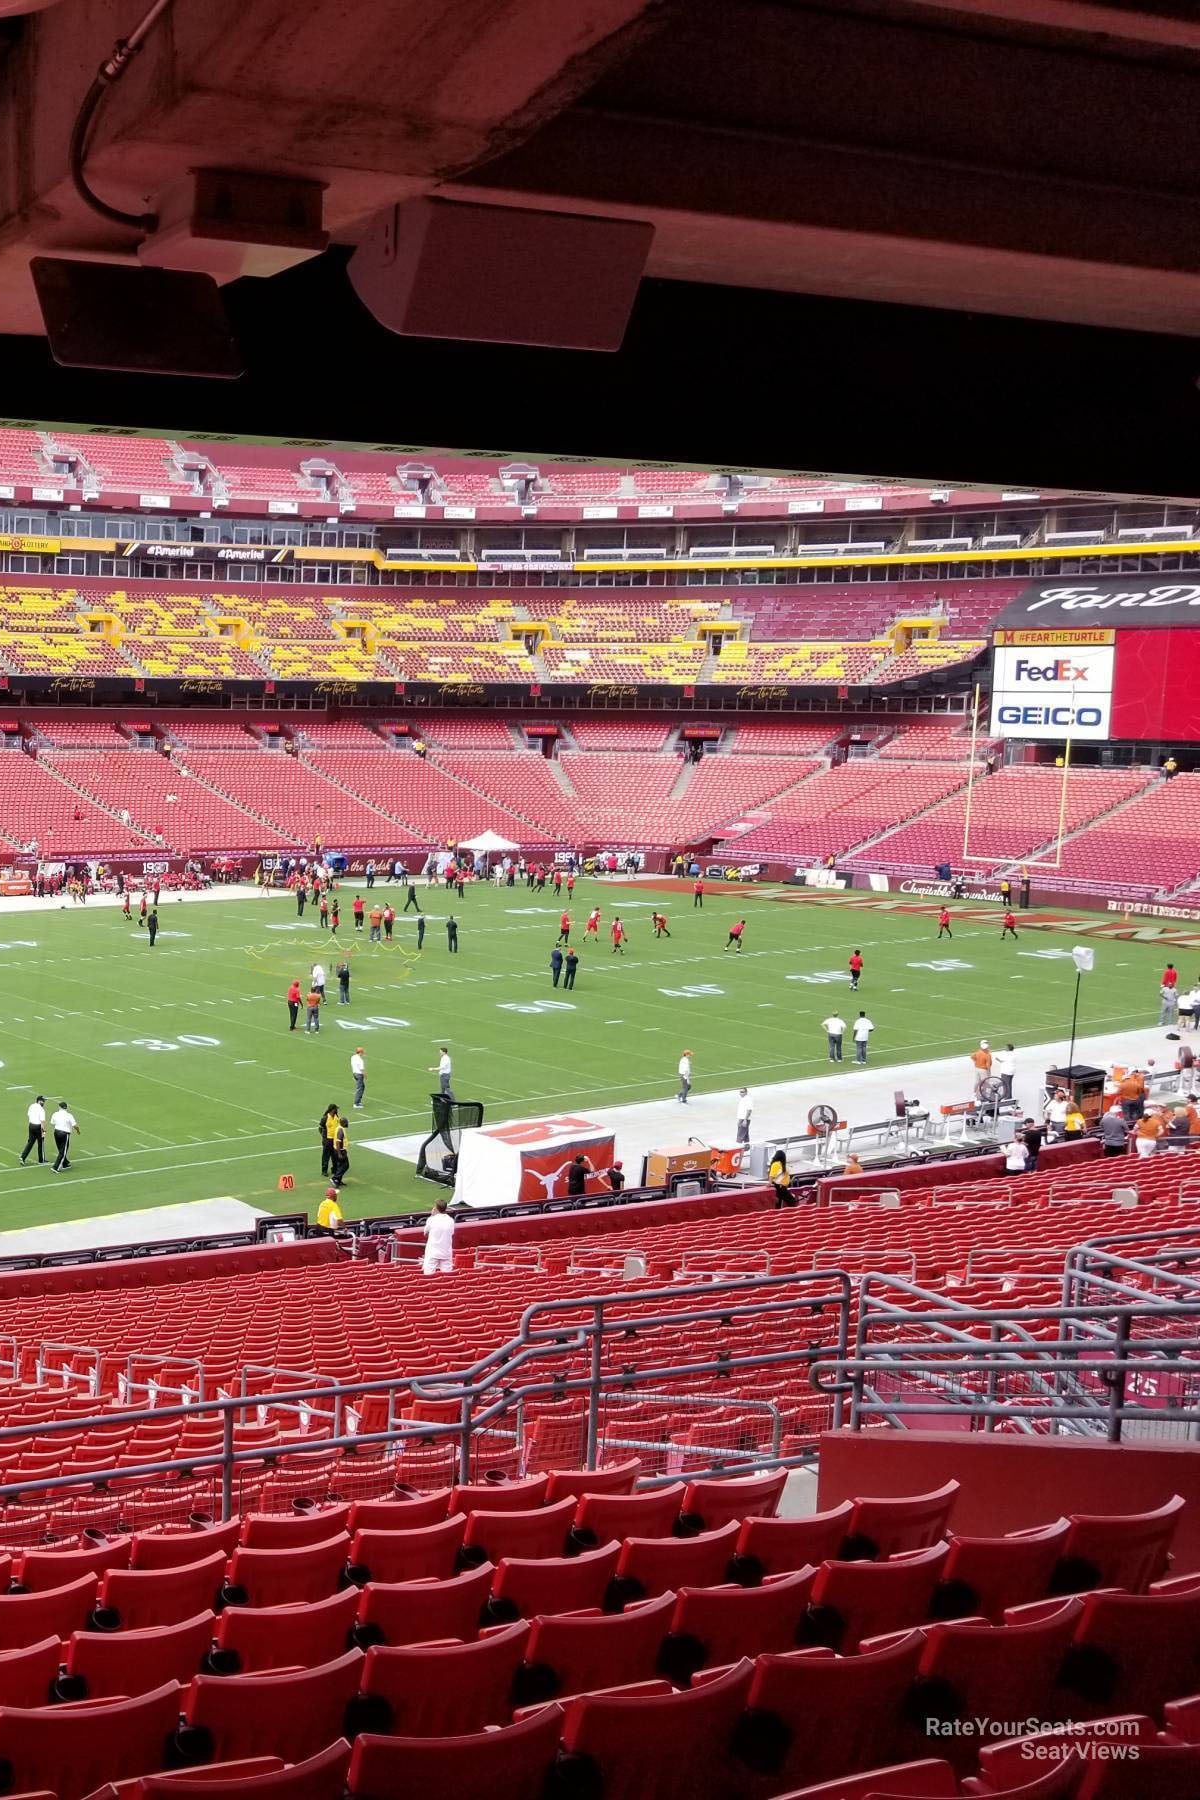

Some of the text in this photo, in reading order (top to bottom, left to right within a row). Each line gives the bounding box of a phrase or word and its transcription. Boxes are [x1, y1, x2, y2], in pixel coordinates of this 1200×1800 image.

[23, 541, 49, 549] LOTTERY
[155, 546, 194, 557] Ameritel
[226, 548, 265, 559] Ameritel
[1027, 585, 1200, 611] FanD
[1015, 659, 1089, 681] FedEx
[997, 706, 1102, 727] GEICO
[900, 880, 952, 897] Charitable
[496, 999, 577, 1014] 50
[335, 1016, 412, 1031] 40
[131, 1034, 221, 1051] 30
[731, 1152, 742, 1168] G
[282, 1175, 294, 1190] 20
